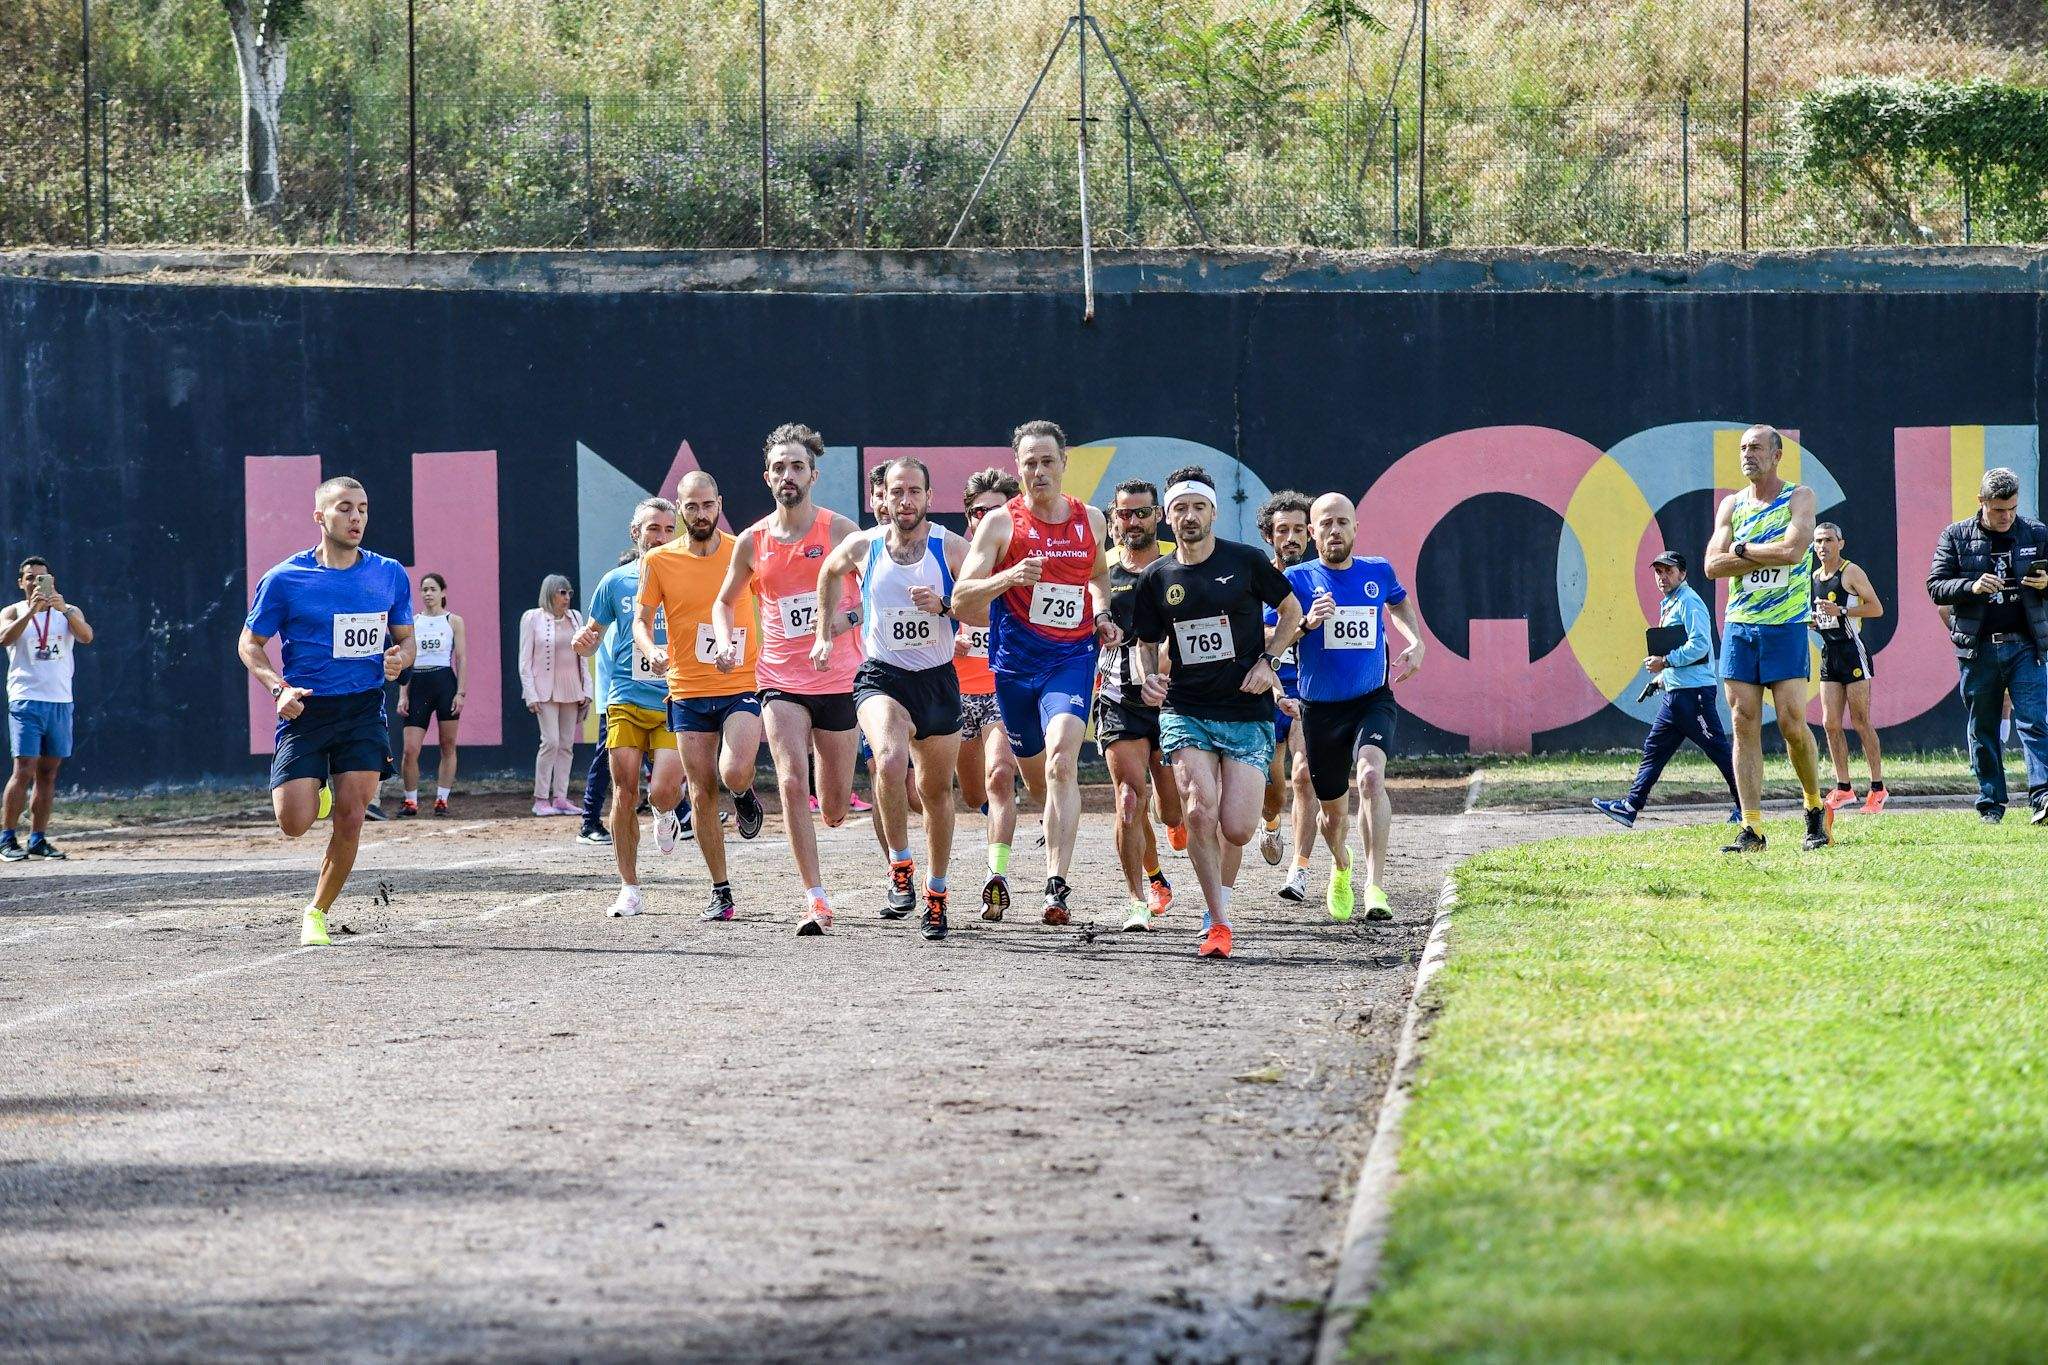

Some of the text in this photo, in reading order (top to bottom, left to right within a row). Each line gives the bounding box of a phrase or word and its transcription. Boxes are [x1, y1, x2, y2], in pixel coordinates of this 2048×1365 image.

[1046, 550, 1088, 558] MARATHON
[1750, 568, 1781, 584] 807
[790, 606, 817, 627] 87
[1042, 597, 1077, 619] 736
[344, 628, 379, 647] 806
[893, 620, 930, 640] 886
[1334, 621, 1369, 639] 868
[421, 639, 441, 650] 859
[971, 632, 990, 648] 69
[1186, 632, 1223, 654] 769
